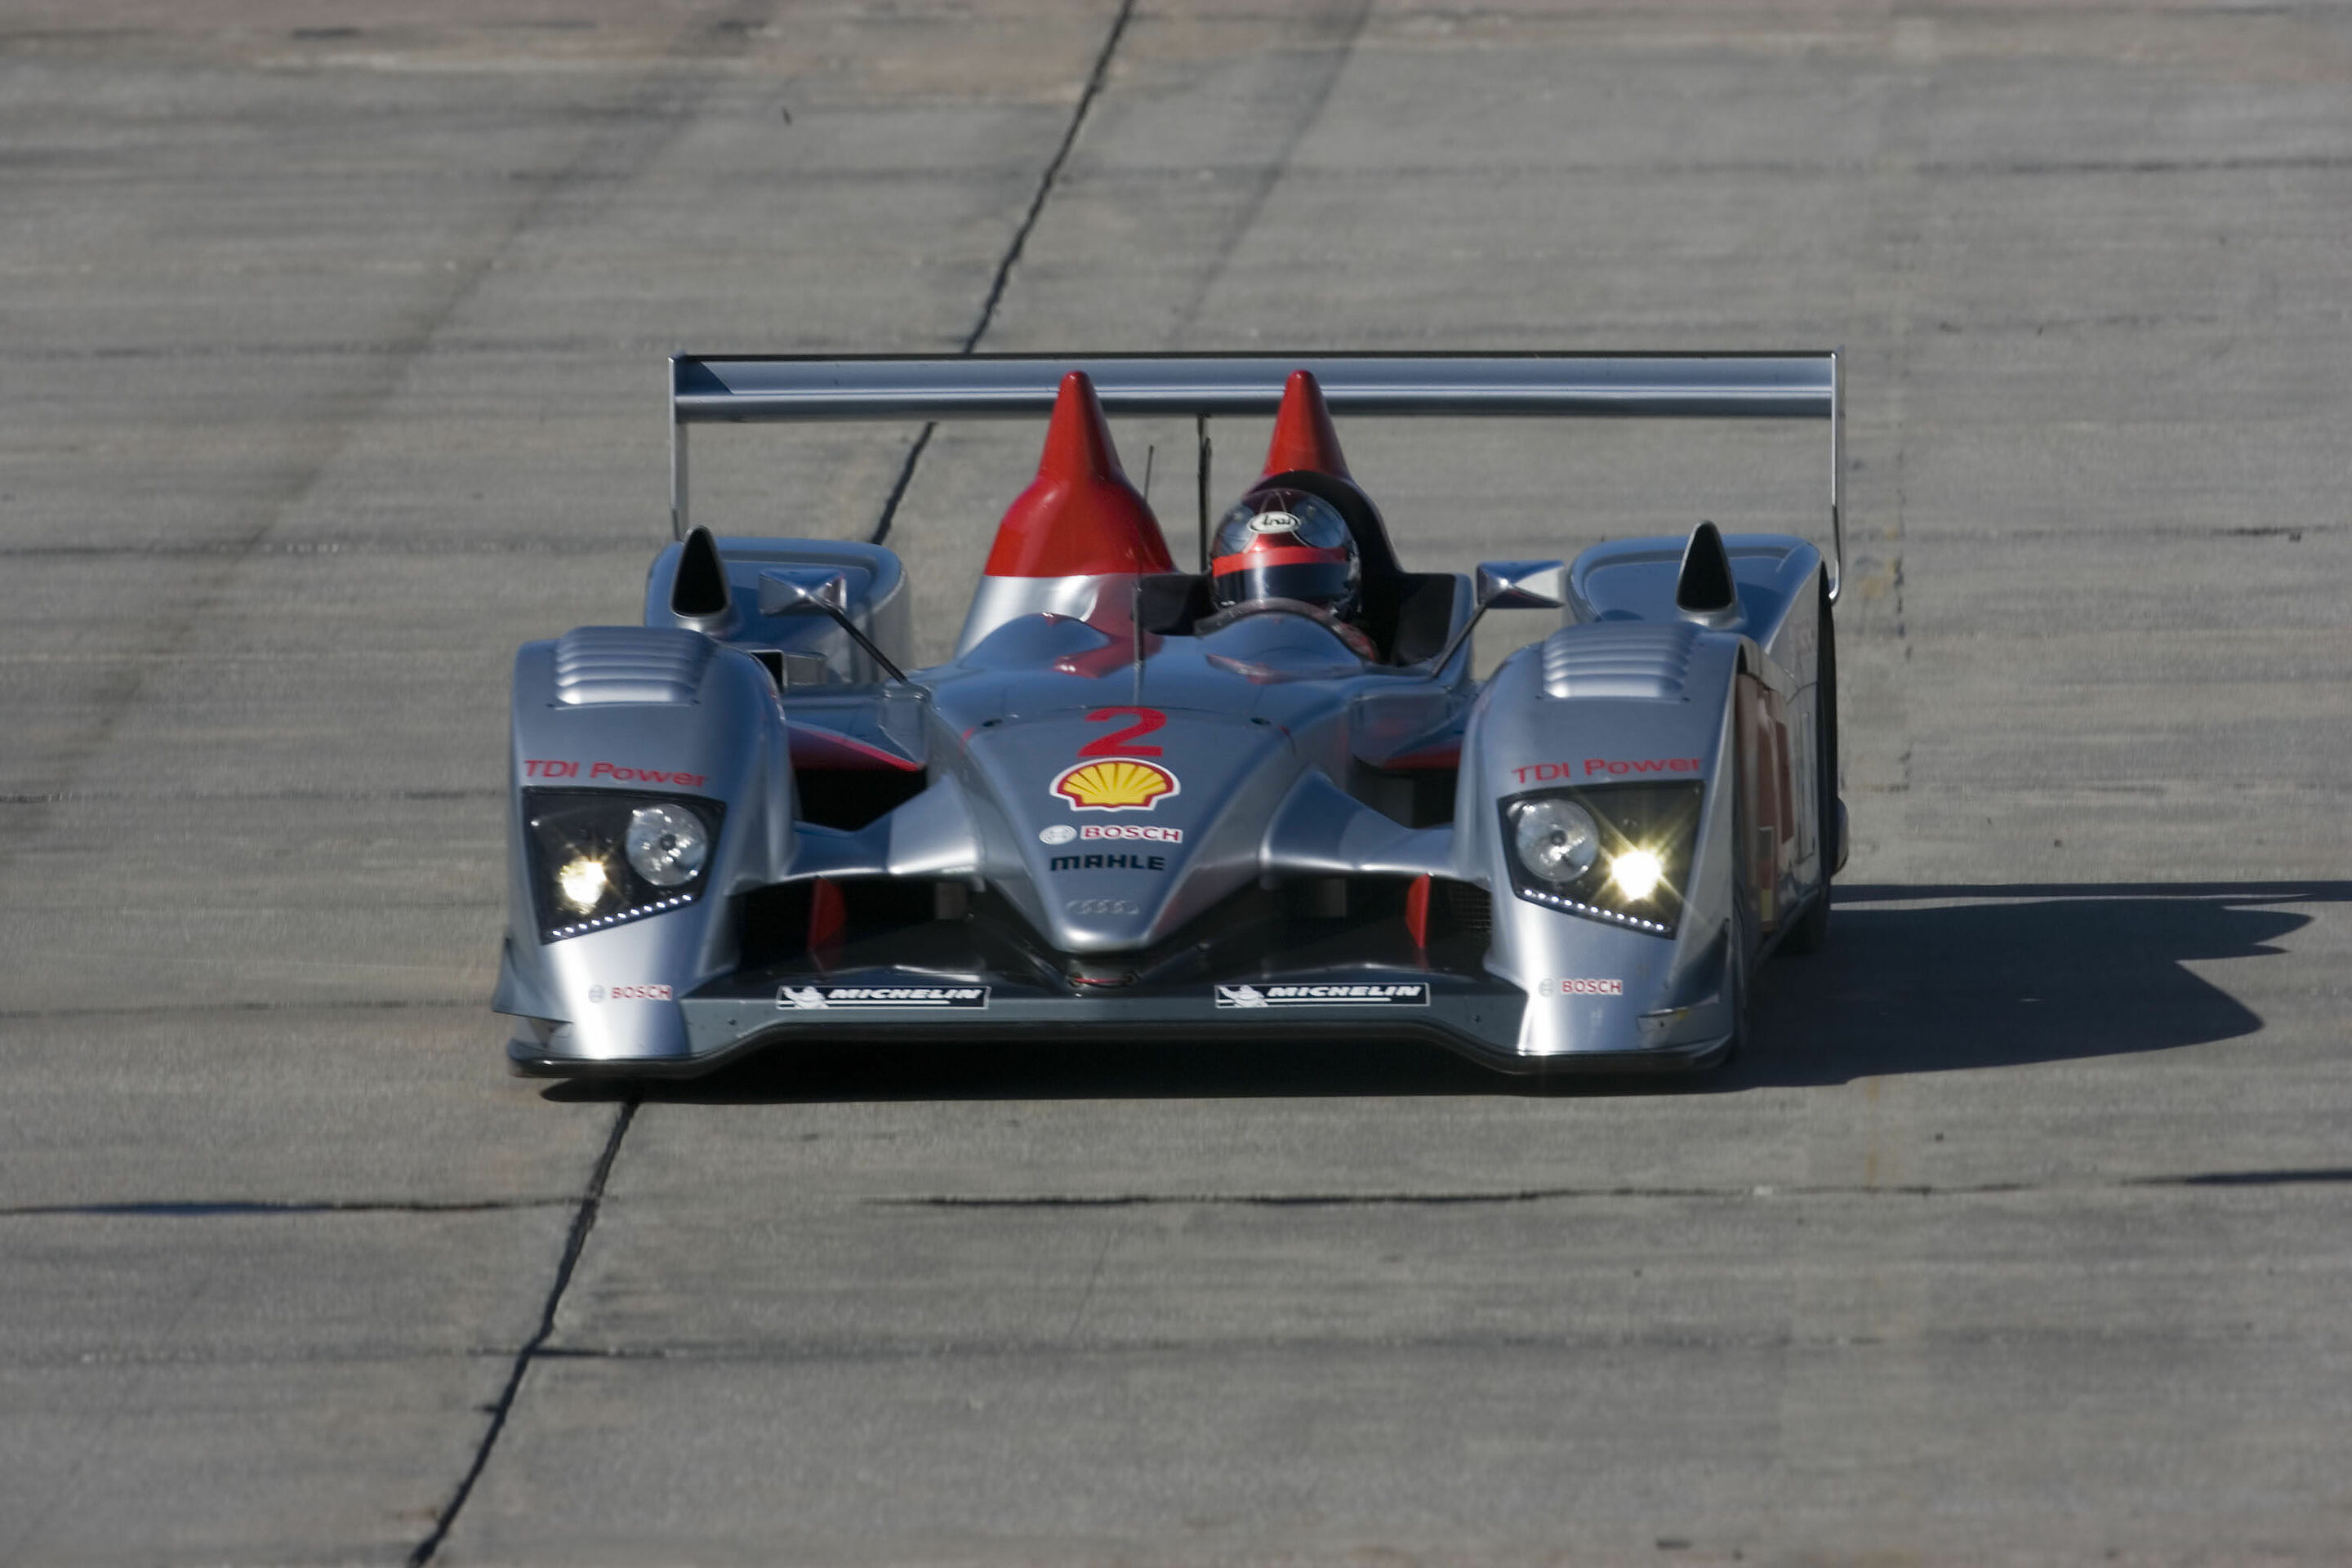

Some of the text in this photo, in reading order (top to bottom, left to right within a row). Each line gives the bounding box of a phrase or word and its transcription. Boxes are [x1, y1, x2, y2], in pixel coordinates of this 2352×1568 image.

[1077, 706, 1167, 758] 2
[523, 760, 707, 787] TDI Power
[1512, 757, 1702, 784] TDI Power
[1083, 826, 1181, 843] BOSCH
[1049, 854, 1165, 871] MAHLE
[611, 986, 671, 1000] BOSCH
[827, 988, 983, 1000] MICHELIN
[1266, 986, 1422, 997] MICHELIN
[1561, 979, 1622, 994] BOSCH
